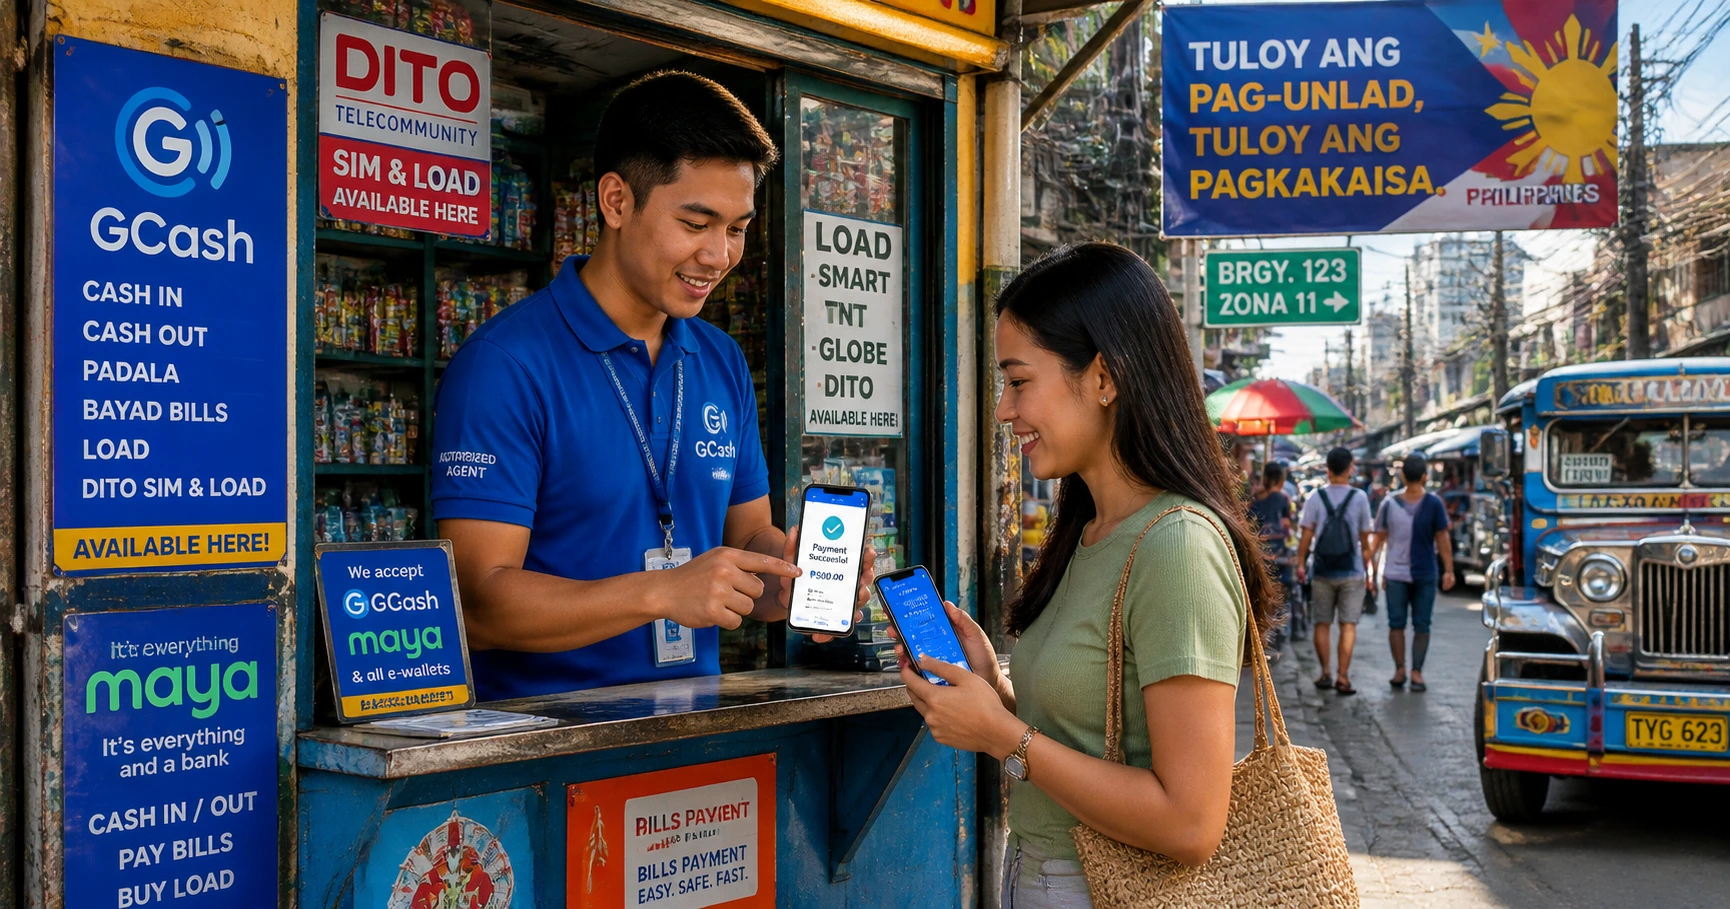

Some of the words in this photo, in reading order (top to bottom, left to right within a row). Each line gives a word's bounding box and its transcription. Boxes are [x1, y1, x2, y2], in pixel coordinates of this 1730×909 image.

[1188, 39, 1311, 71] TULOY
[1319, 36, 1401, 68] ANG
[335, 33, 480, 113] DITO
[1189, 79, 1424, 114] PAG-UNLAD,
[335, 104, 478, 147] TELECOMMUNITY
[1189, 125, 1311, 157] TULOY
[1319, 122, 1401, 154] ANG
[333, 149, 381, 182] SIM
[388, 158, 407, 186] &
[414, 163, 480, 196] LOAD
[1190, 165, 1447, 200] PAGKAKAISA.
[332, 187, 430, 218] AVAILABLE
[434, 202, 479, 225] HERE
[90, 207, 254, 264] GCash
[815, 221, 892, 260] LOAD
[818, 263, 891, 294] SMART
[1218, 260, 1295, 286] BRGY.
[1301, 258, 1347, 284] 123
[83, 280, 151, 304] CASH
[158, 286, 183, 307] IN
[1219, 292, 1289, 316] ZONA
[1296, 292, 1317, 315] 11
[825, 300, 868, 328] TNT
[83, 320, 151, 344] CASH
[158, 325, 208, 347] OUT
[819, 337, 888, 365] GLOBE
[83, 360, 180, 383] PADALA
[824, 374, 874, 400] DITO
[83, 399, 162, 421] BAYAD
[169, 402, 228, 422] BILLS
[809, 409, 867, 426] AVAILABLE
[83, 438, 150, 460] LOAD
[695, 440, 736, 459] GCash
[446, 465, 487, 479] AGENT
[82, 478, 137, 499] DITO
[143, 477, 182, 498] SIM
[189, 478, 204, 498] &
[210, 477, 267, 497] LOAD
[73, 535, 201, 560] AVAILABLE
[207, 532, 270, 554] HERE!
[812, 543, 848, 555] Payment
[348, 565, 371, 579] We
[374, 563, 424, 580] accept
[371, 590, 439, 612] GCash
[348, 626, 443, 659] maya
[352, 671, 363, 683] &
[367, 668, 384, 682] all
[388, 663, 451, 680] e-wallets
[86, 661, 258, 719] maya
[102, 736, 135, 757] It's
[141, 726, 245, 752] everything
[1631, 718, 1673, 740] TYG
[1681, 720, 1722, 744] 623
[119, 757, 157, 778] and
[163, 759, 175, 773] a
[181, 750, 229, 771] bank
[88, 806, 156, 836] CASH
[163, 802, 186, 825] IN
[193, 798, 204, 824] /
[211, 791, 257, 818] OUT
[635, 812, 681, 837] BILLS
[119, 842, 165, 870] PAY
[172, 832, 234, 861] BILLS
[638, 859, 677, 883] BILLS
[682, 844, 748, 873] PAYMENT
[118, 880, 167, 909] BUY
[174, 869, 235, 899] LOAD
[638, 882, 675, 905] EASY.
[678, 874, 713, 895] SAFE.
[716, 866, 749, 886] FAST.
